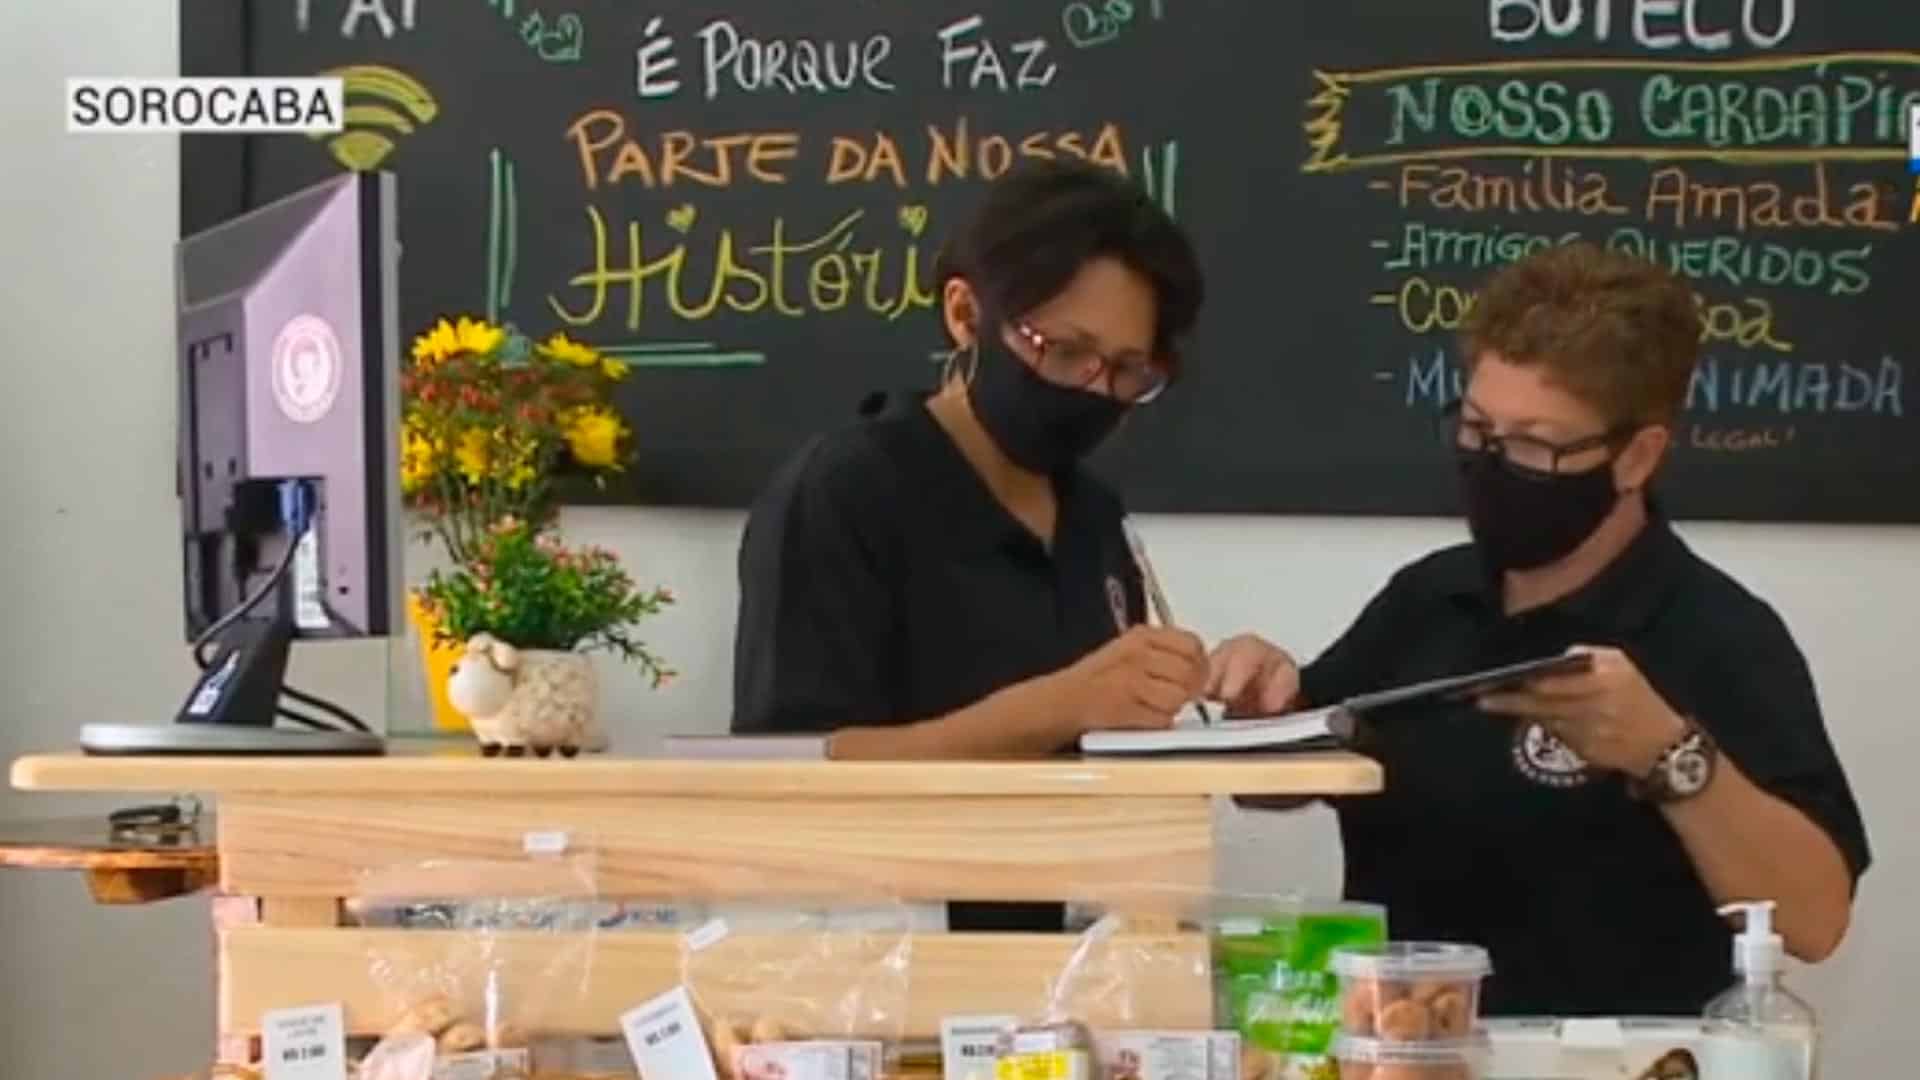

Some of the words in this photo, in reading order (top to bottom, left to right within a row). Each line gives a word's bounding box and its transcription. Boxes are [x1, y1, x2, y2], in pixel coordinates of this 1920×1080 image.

[636, 19, 681, 97] É
[937, 15, 1057, 90] FAZ
[567, 110, 800, 188] PARTE
[826, 136, 904, 187] DA
[1385, 80, 1614, 144] NOSSO
[1645, 160, 1898, 230] Amada
[549, 204, 936, 330] Históri
[1686, 356, 1904, 415] NIMADA
